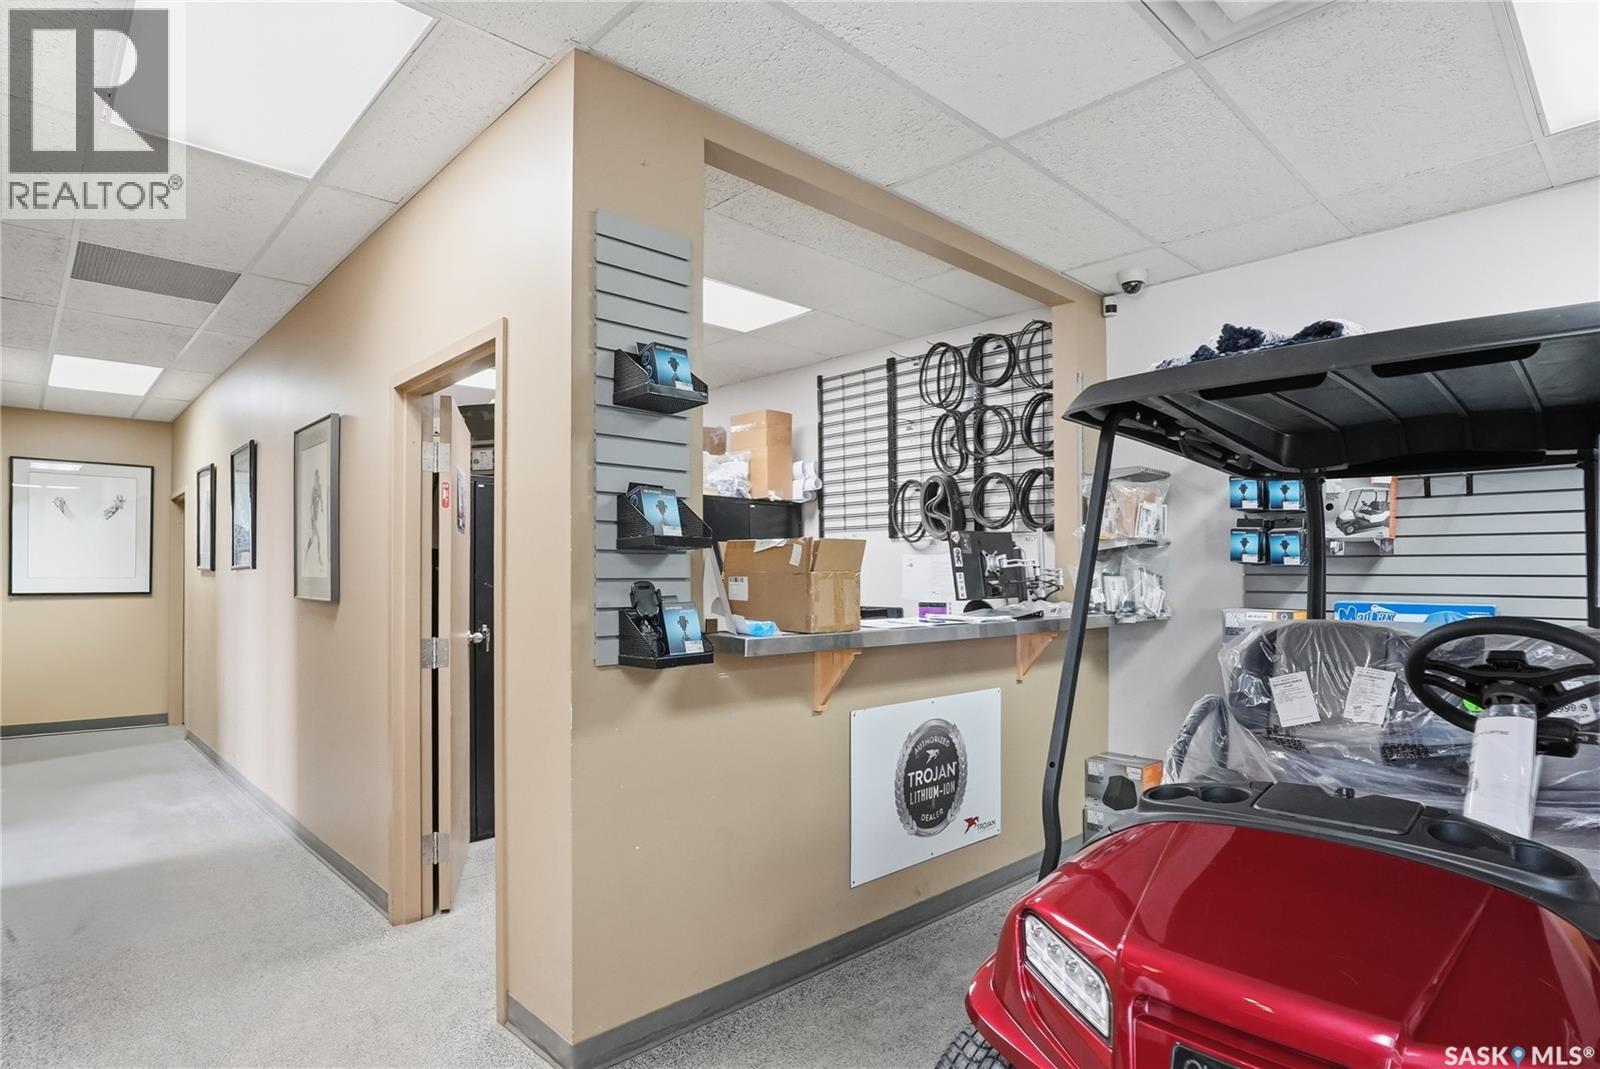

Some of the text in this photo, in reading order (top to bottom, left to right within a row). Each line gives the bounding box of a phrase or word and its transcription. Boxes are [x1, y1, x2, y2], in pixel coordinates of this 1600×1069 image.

[914, 736, 951, 758] AUTHORIZED
[907, 761, 958, 788] TROJAN
[909, 780, 956, 806] LITHIUM-ION
[920, 807, 944, 822] DEALER
